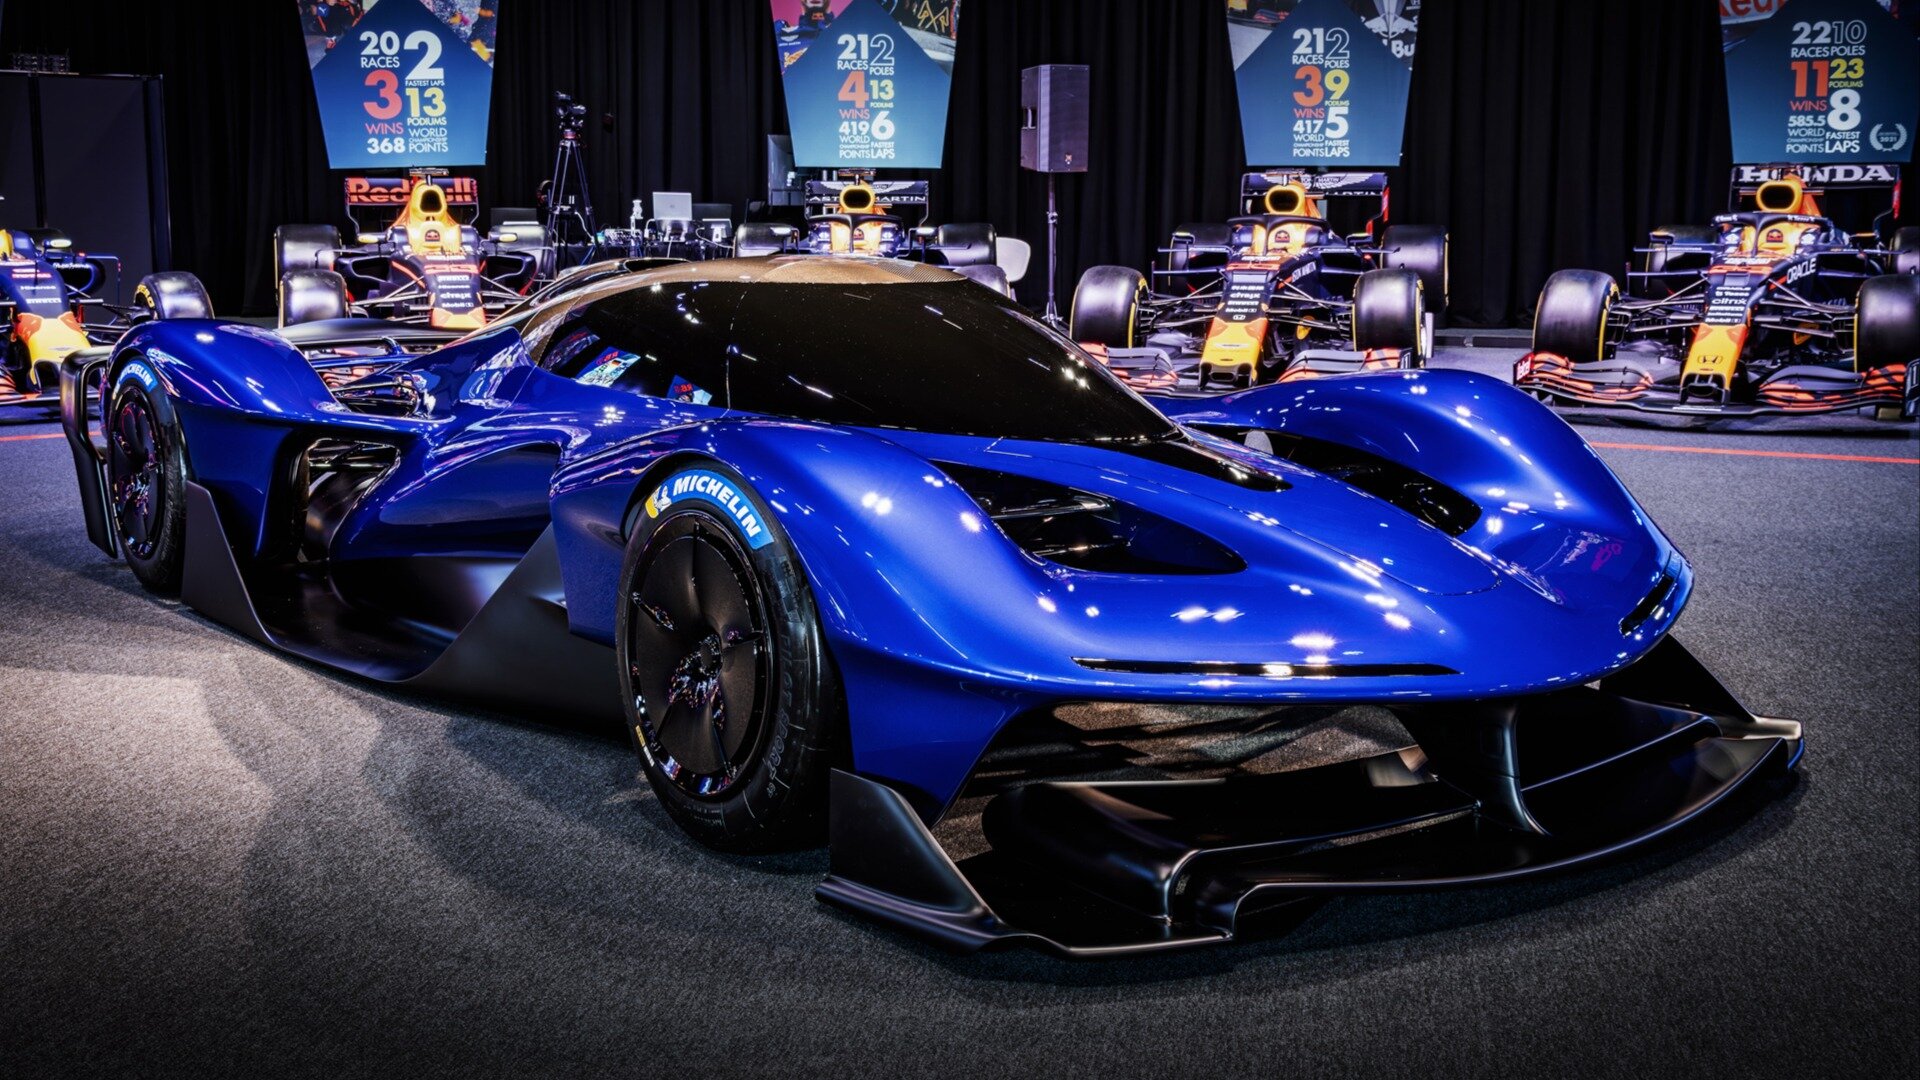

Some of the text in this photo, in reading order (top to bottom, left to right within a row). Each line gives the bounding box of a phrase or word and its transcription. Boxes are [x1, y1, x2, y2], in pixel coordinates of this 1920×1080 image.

[1791, 21, 1832, 45] 22
[1832, 20, 1867, 45] 10
[360, 31, 400, 56] 20
[838, 34, 868, 60] 21
[1292, 28, 1324, 54] 21
[1325, 27, 1350, 60] 2
[404, 30, 444, 80] 2
[870, 34, 895, 66] 2
[1791, 47, 1829, 58] RACES
[1830, 45, 1866, 56] POLES
[361, 57, 400, 68] RACES
[837, 60, 869, 70] RACES
[1292, 54, 1324, 65] RACES
[1325, 60, 1350, 69] POLES
[870, 66, 895, 75] POLES
[1829, 58, 1865, 79] 23
[1293, 65, 1324, 107] 3
[1324, 69, 1350, 100] 9
[1791, 61, 1829, 98] 11
[364, 69, 402, 120] 3
[838, 71, 869, 108] 4
[870, 79, 895, 100] 13
[405, 87, 447, 117] 13
[1790, 100, 1828, 112] WINS
[839, 109, 870, 119] WINS
[1294, 108, 1325, 119] WINS
[1827, 88, 1862, 131] 8
[407, 117, 447, 126] PODIUMS
[839, 121, 870, 135] 419
[871, 110, 895, 140] 6
[1293, 120, 1324, 134] 417
[1325, 106, 1349, 139] 5
[1788, 115, 1826, 127] 585.5
[365, 123, 404, 134] WINS
[408, 128, 447, 137] WORLD
[1787, 127, 1825, 137] WORLD
[1825, 131, 1861, 139] FASTEST
[840, 135, 870, 144] WORLD
[1293, 133, 1325, 142] WORLD
[367, 137, 405, 154] 368
[409, 143, 448, 153] POINTS
[1293, 148, 1325, 157] POINTS
[1325, 147, 1350, 157] LAPS
[1785, 144, 1825, 154] POINTS
[1825, 140, 1861, 154] LAPS
[840, 149, 870, 159] POINTS
[871, 149, 895, 159] LAPS
[1786, 258, 1816, 284] ORACLE
[673, 475, 761, 537] MICHELIN
